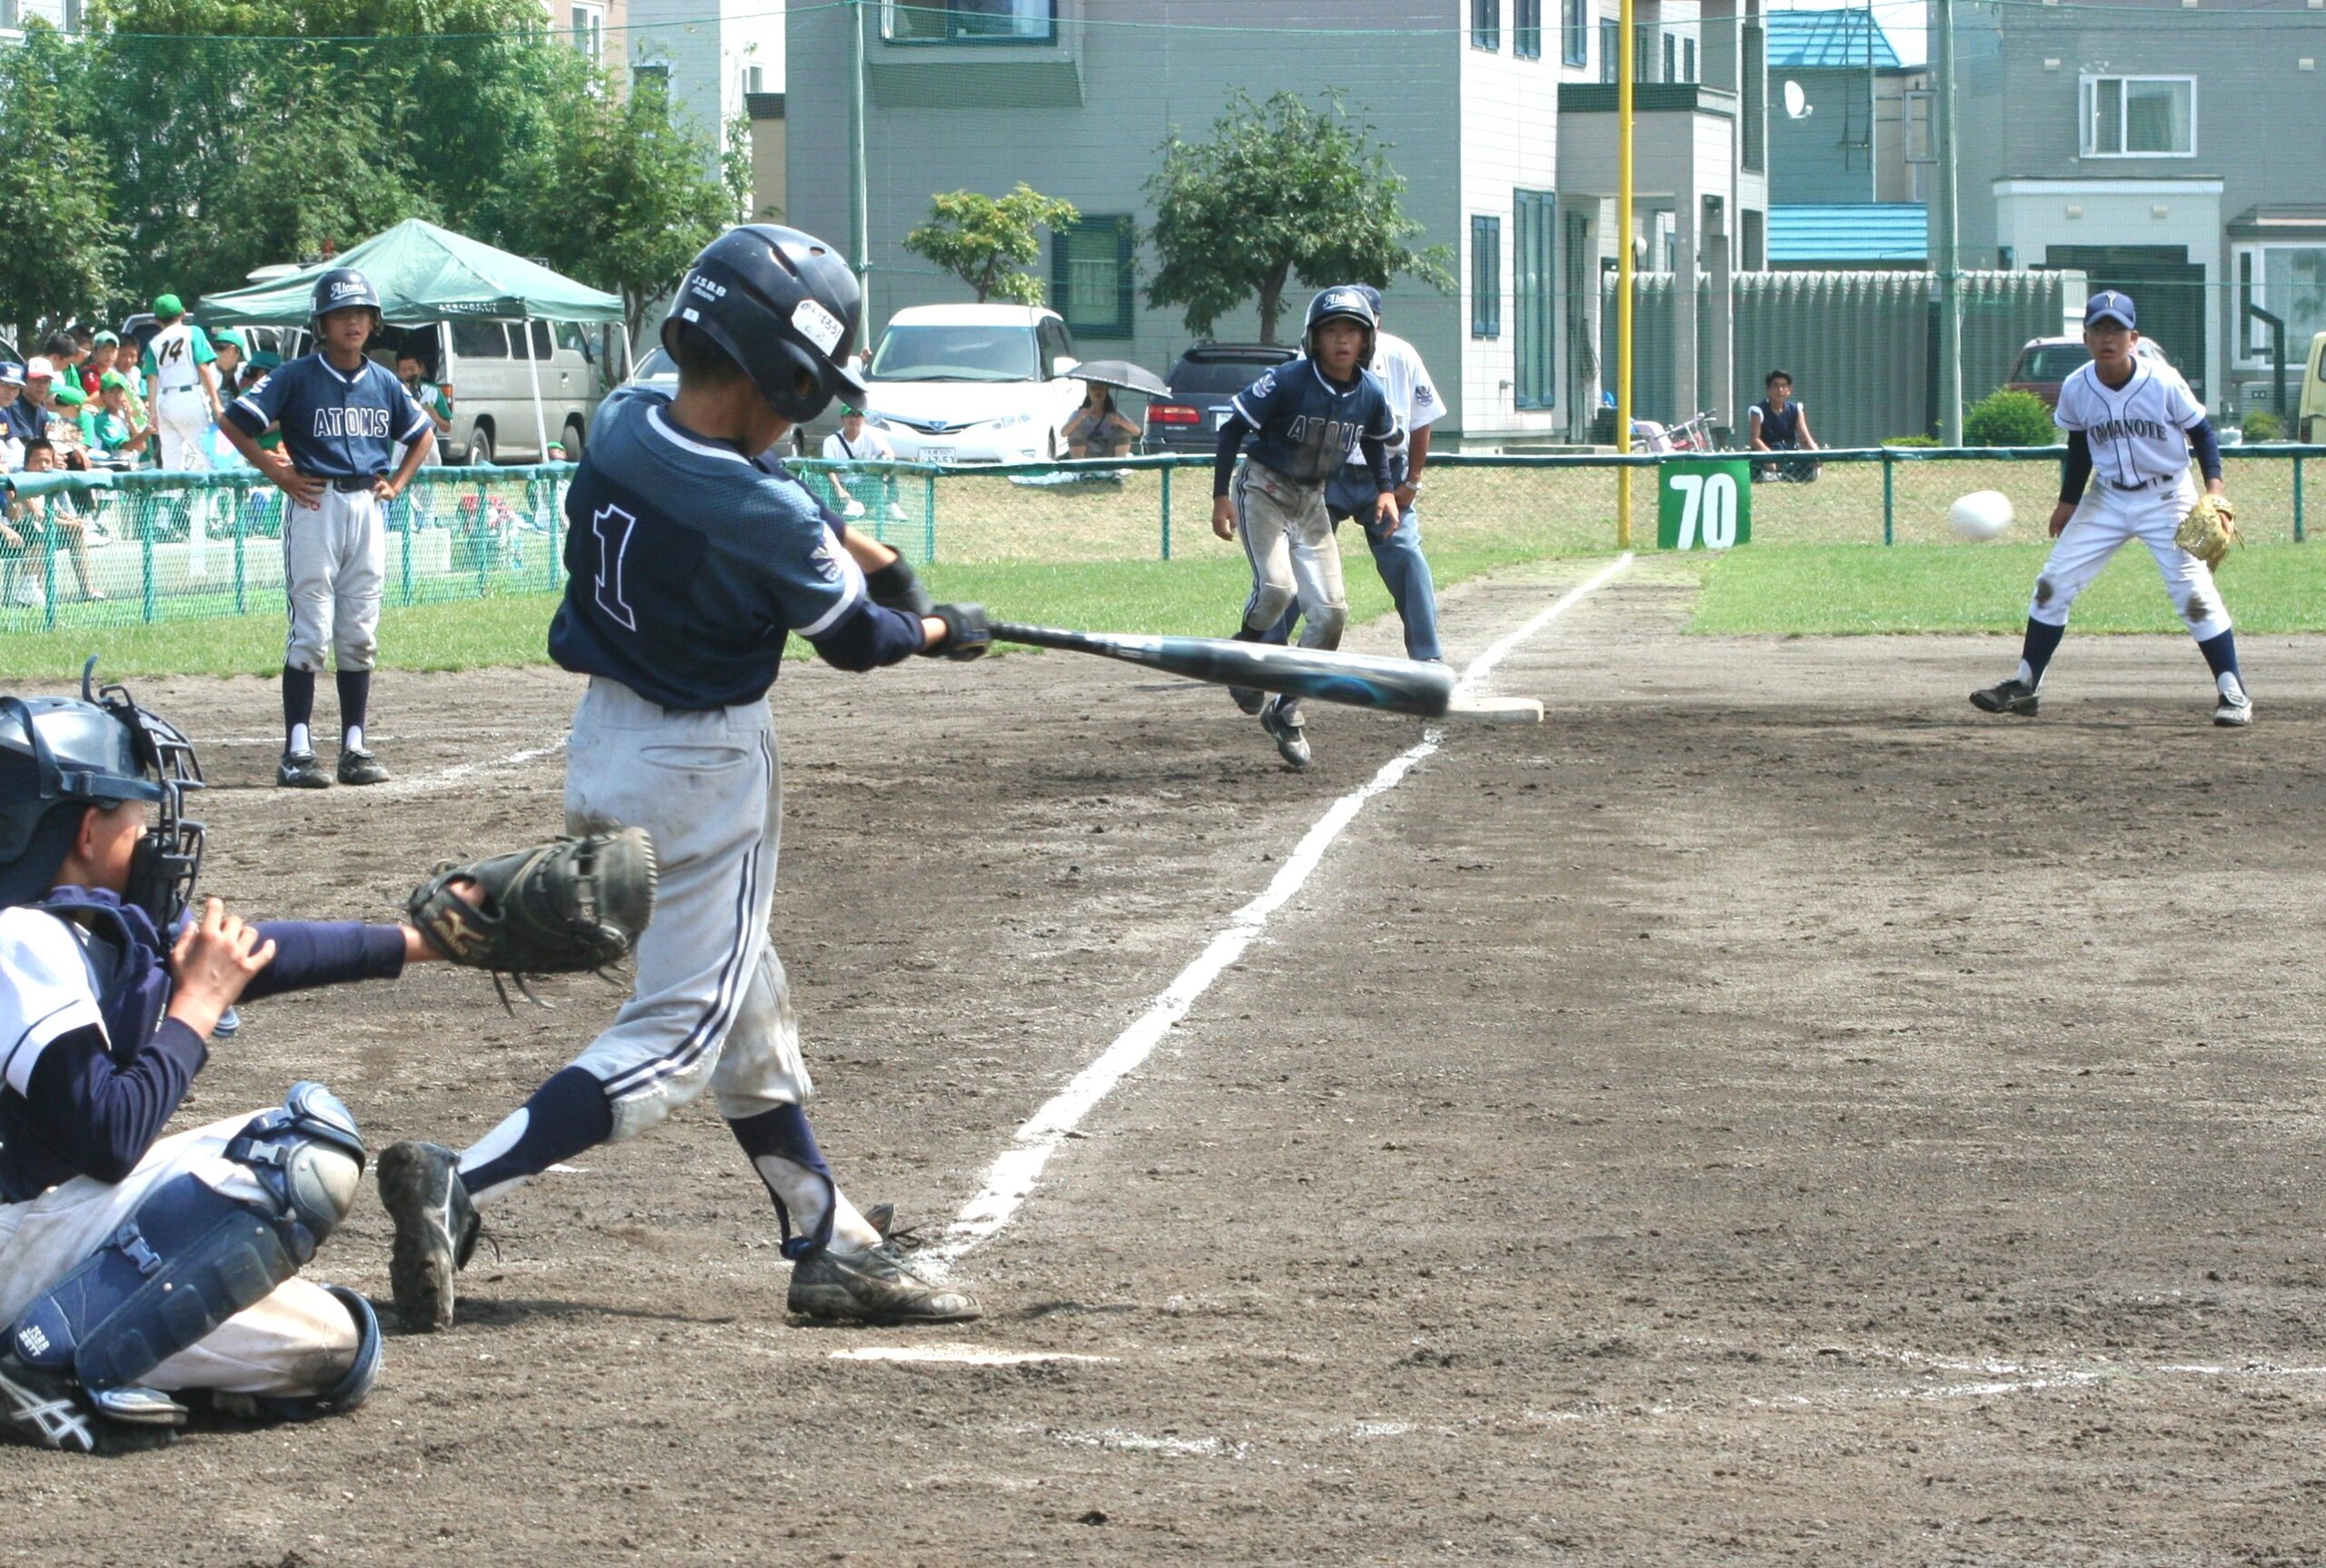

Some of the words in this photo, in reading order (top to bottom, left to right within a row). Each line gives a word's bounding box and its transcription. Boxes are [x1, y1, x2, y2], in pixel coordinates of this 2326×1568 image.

[159, 337, 184, 366] 14
[313, 407, 390, 438] ATOMS
[1669, 472, 1737, 551] 70
[592, 503, 636, 632] 1
[26, 1325, 50, 1352] JSBB
